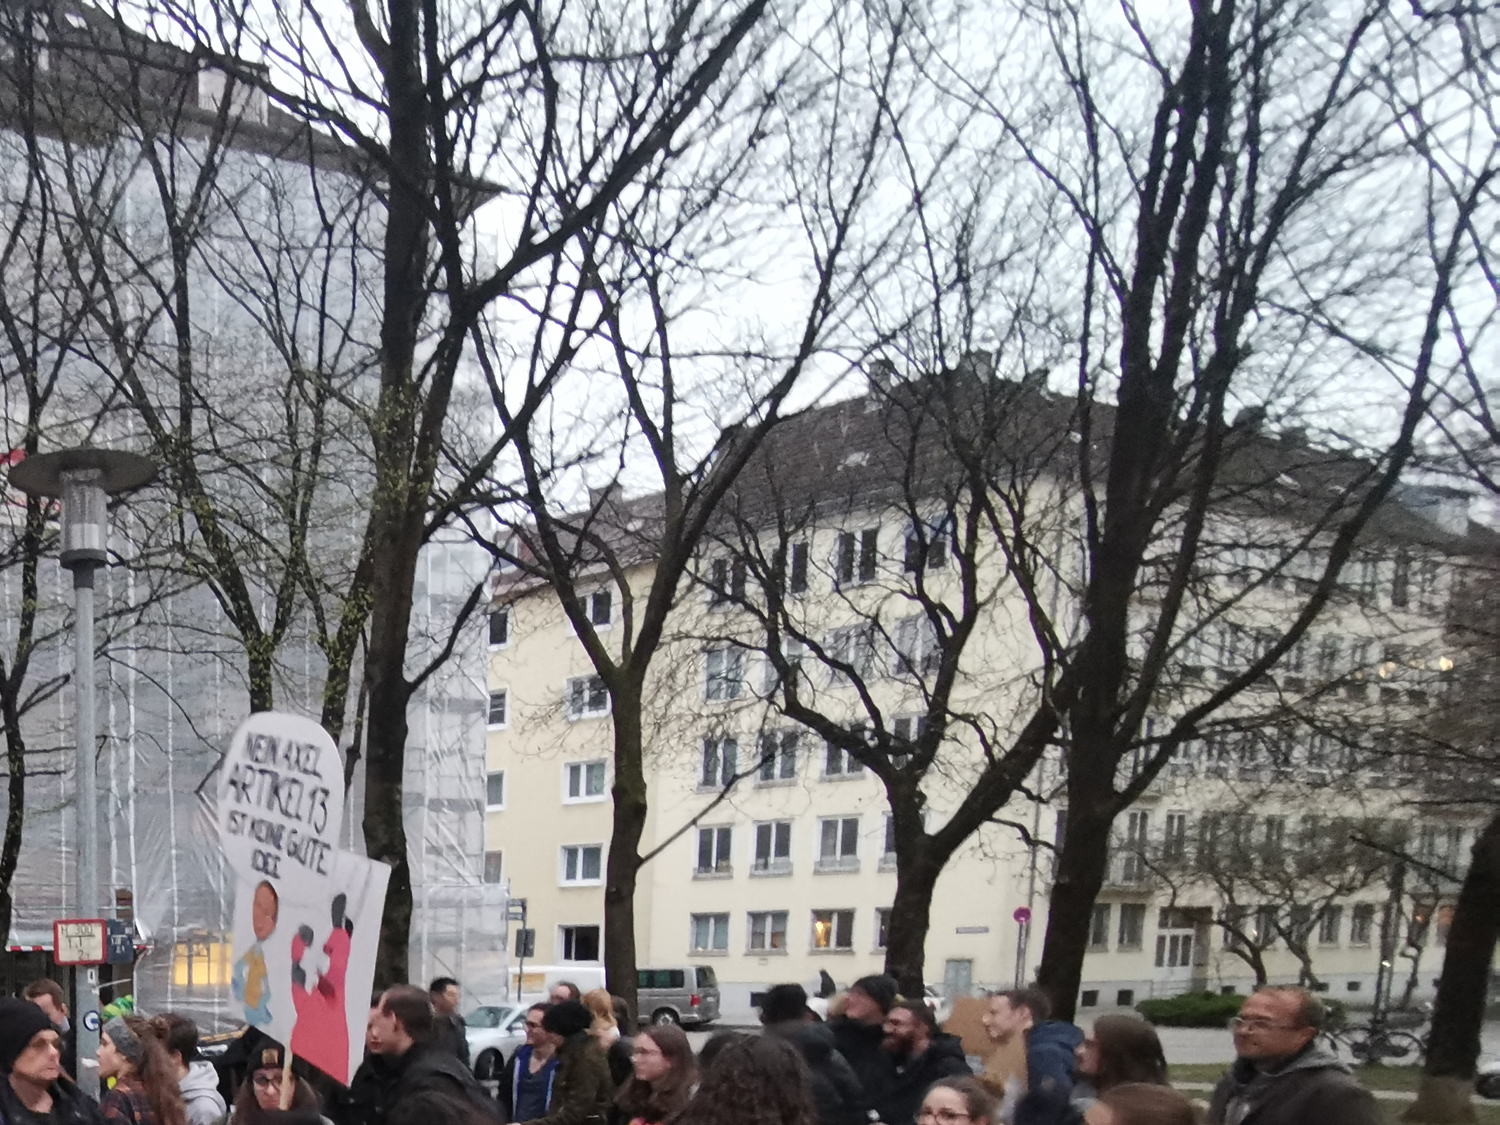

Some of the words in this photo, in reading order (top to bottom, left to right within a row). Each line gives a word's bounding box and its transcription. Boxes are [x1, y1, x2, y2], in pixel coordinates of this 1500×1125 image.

[246, 731, 279, 763] NEIN
[282, 739, 322, 779] AXEL
[224, 762, 304, 822] ARTIKEL
[308, 785, 330, 836] 13
[286, 828, 332, 876] GUTE
